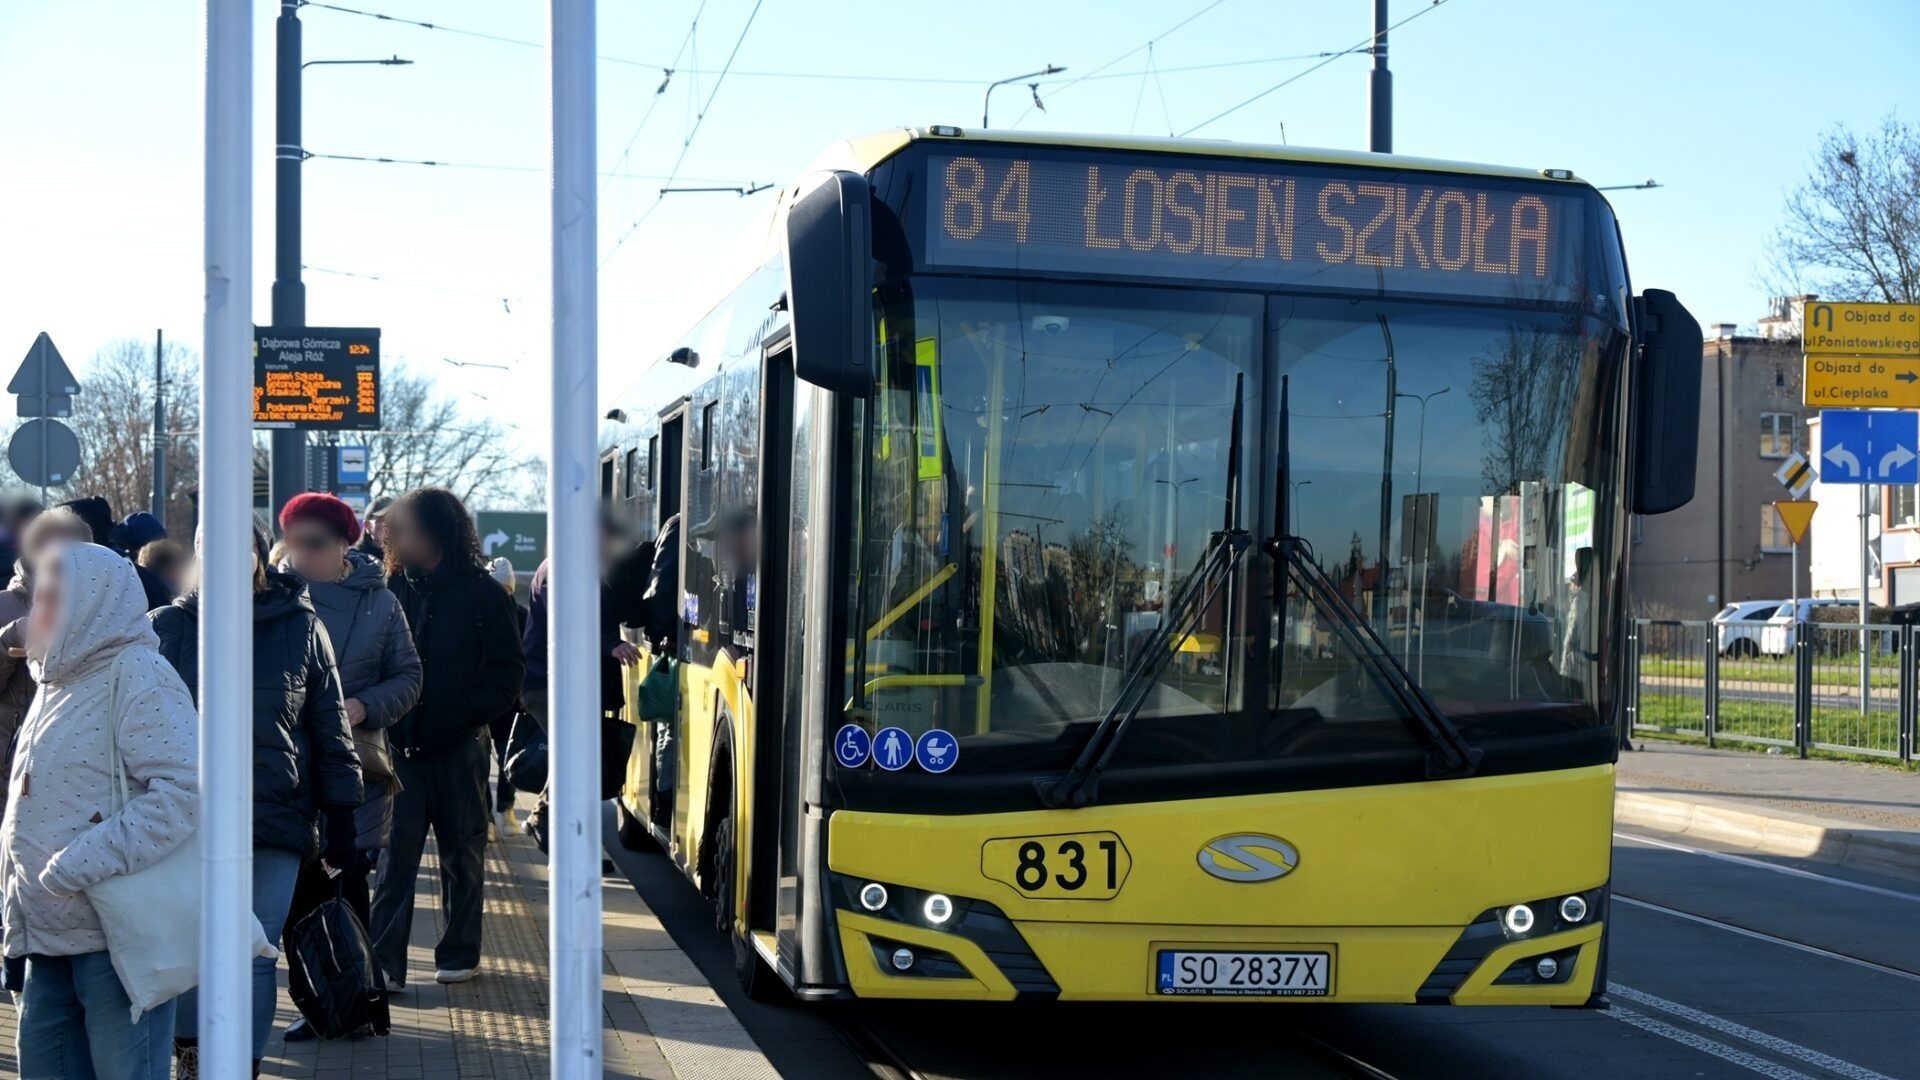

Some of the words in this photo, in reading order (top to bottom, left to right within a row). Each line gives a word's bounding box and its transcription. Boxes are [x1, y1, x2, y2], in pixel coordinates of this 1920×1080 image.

[944, 156, 1031, 244] 84
[1084, 165, 1296, 261] ŁOSIEŃ
[1315, 183, 1549, 277] SZKOŁA
[1844, 311, 1891, 325] Objazd
[1899, 312, 1915, 322] do
[261, 338, 300, 350] Dąbrowa
[302, 338, 341, 349] Górnicza
[279, 351, 303, 363] Aleja
[305, 351, 324, 361] Róż
[1814, 361, 1861, 375] Objazd
[1869, 362, 1885, 373] do
[863, 701, 922, 713] OARIS
[1016, 840, 1117, 892] 831
[1161, 973, 1172, 982] PL
[1181, 956, 1218, 985] SO
[1230, 956, 1320, 987] 2837X
